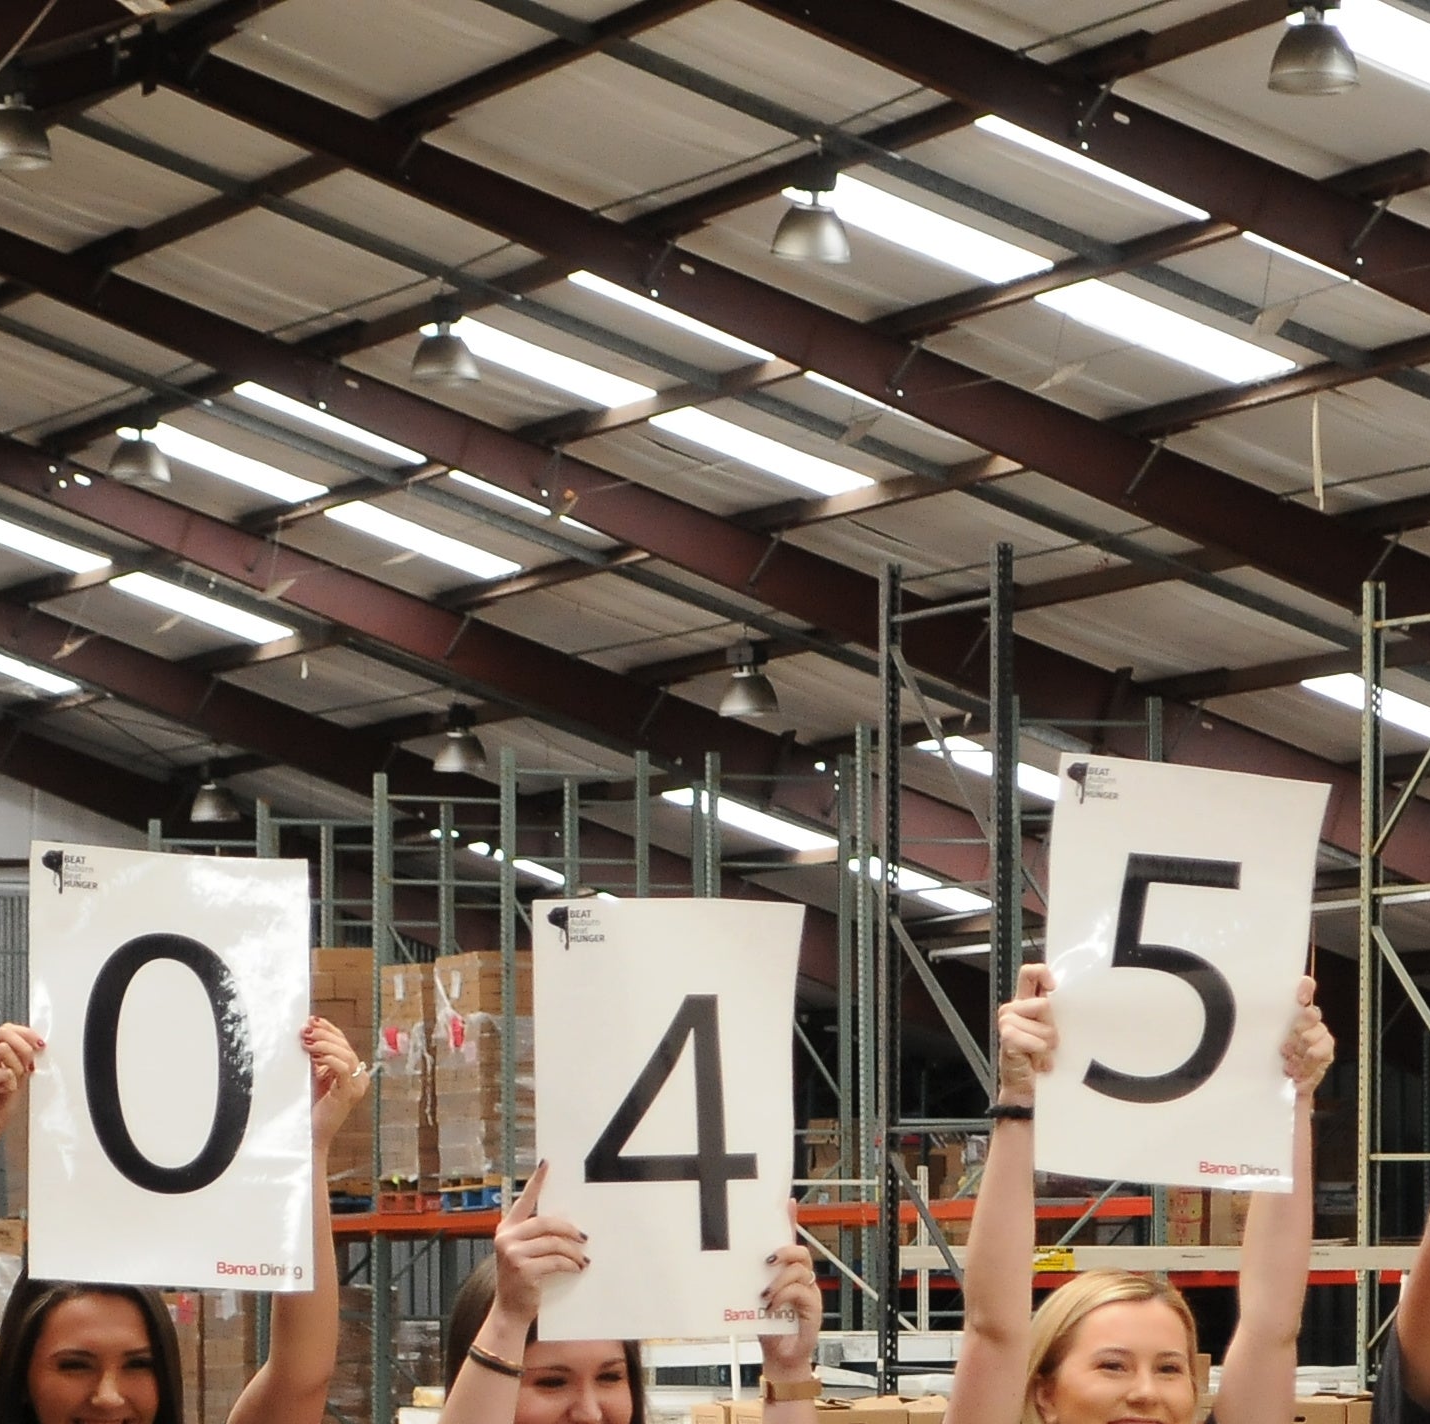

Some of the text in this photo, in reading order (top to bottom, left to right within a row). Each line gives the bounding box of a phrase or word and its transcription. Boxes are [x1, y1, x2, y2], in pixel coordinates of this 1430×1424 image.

[64, 855, 86, 864] BEAT
[64, 881, 98, 889] HUNGER
[570, 910, 592, 918] BEAT
[1084, 855, 1239, 1103] 5
[84, 934, 253, 1194] 0
[585, 996, 756, 1250] 4
[1199, 1161, 1237, 1175] Bama
[216, 1262, 303, 1280] Bama Dinig
[724, 1309, 755, 1321] Bama
